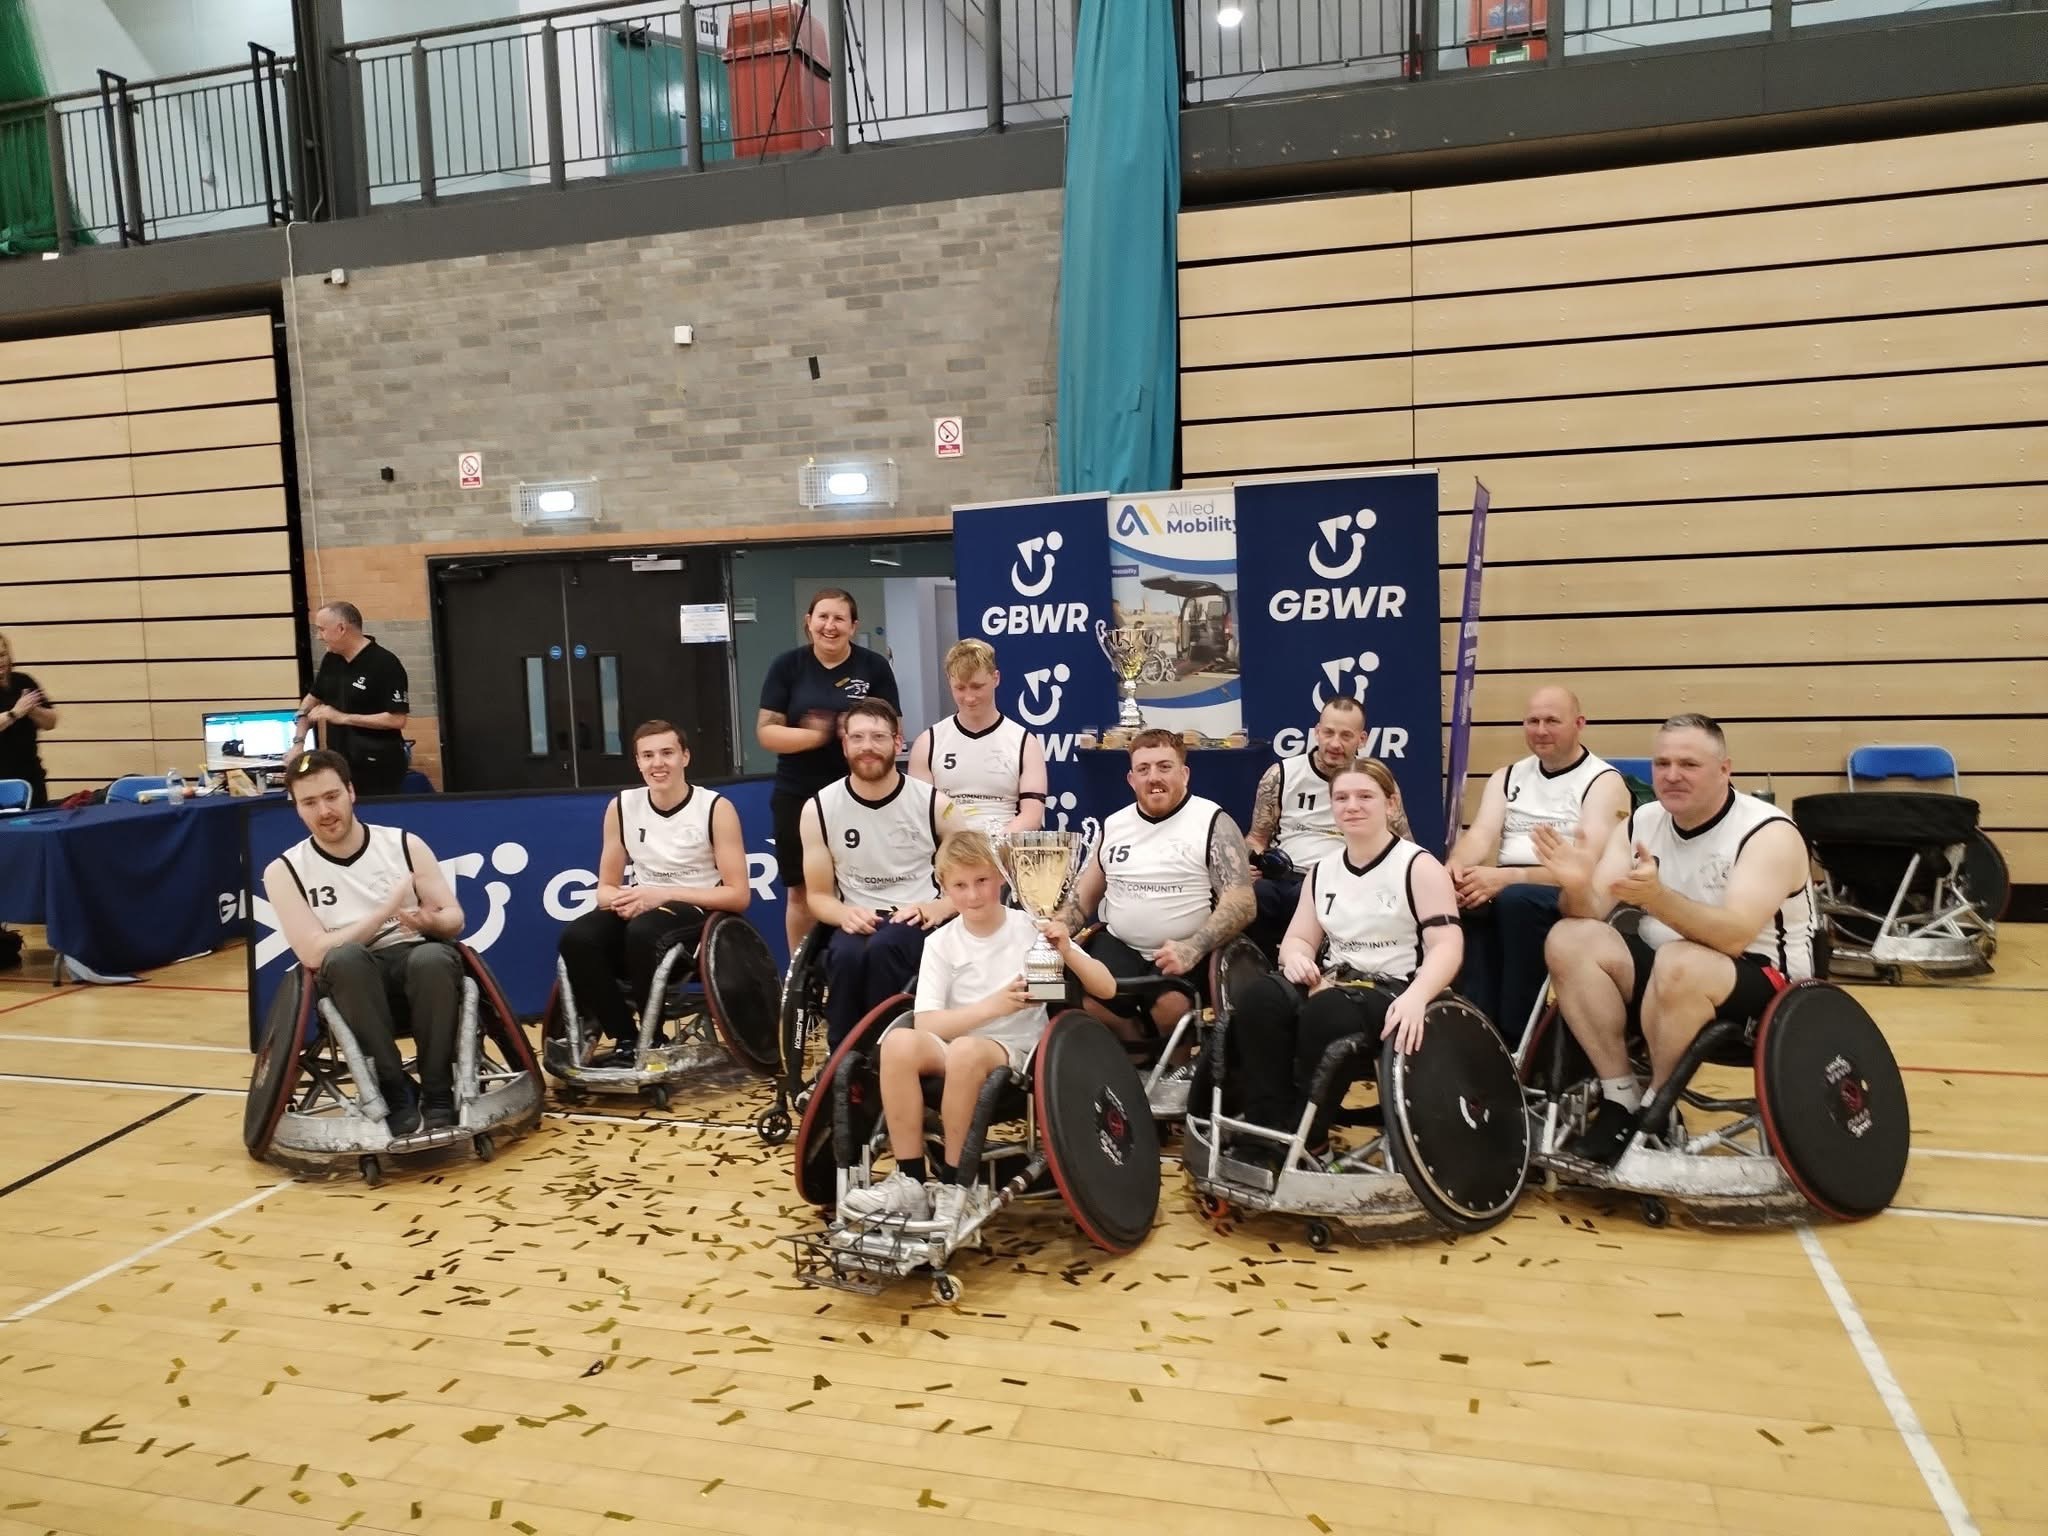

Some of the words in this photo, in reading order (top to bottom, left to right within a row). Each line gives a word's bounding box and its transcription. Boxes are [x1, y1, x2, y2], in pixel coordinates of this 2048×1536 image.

[1167, 499, 1215, 515] Allied
[1268, 585, 1407, 622] GBWR
[981, 602, 1089, 636] GBWR
[1273, 727, 1409, 759] GR
[944, 753, 957, 770] 5
[1297, 792, 1316, 811] 11
[638, 828, 646, 843] 1
[844, 829, 860, 849] 9
[1109, 845, 1131, 864] 15
[309, 886, 338, 907] 13
[543, 852, 778, 922] GR
[1127, 884, 1183, 893] COMMUNITY
[1325, 893, 1336, 915] 7
